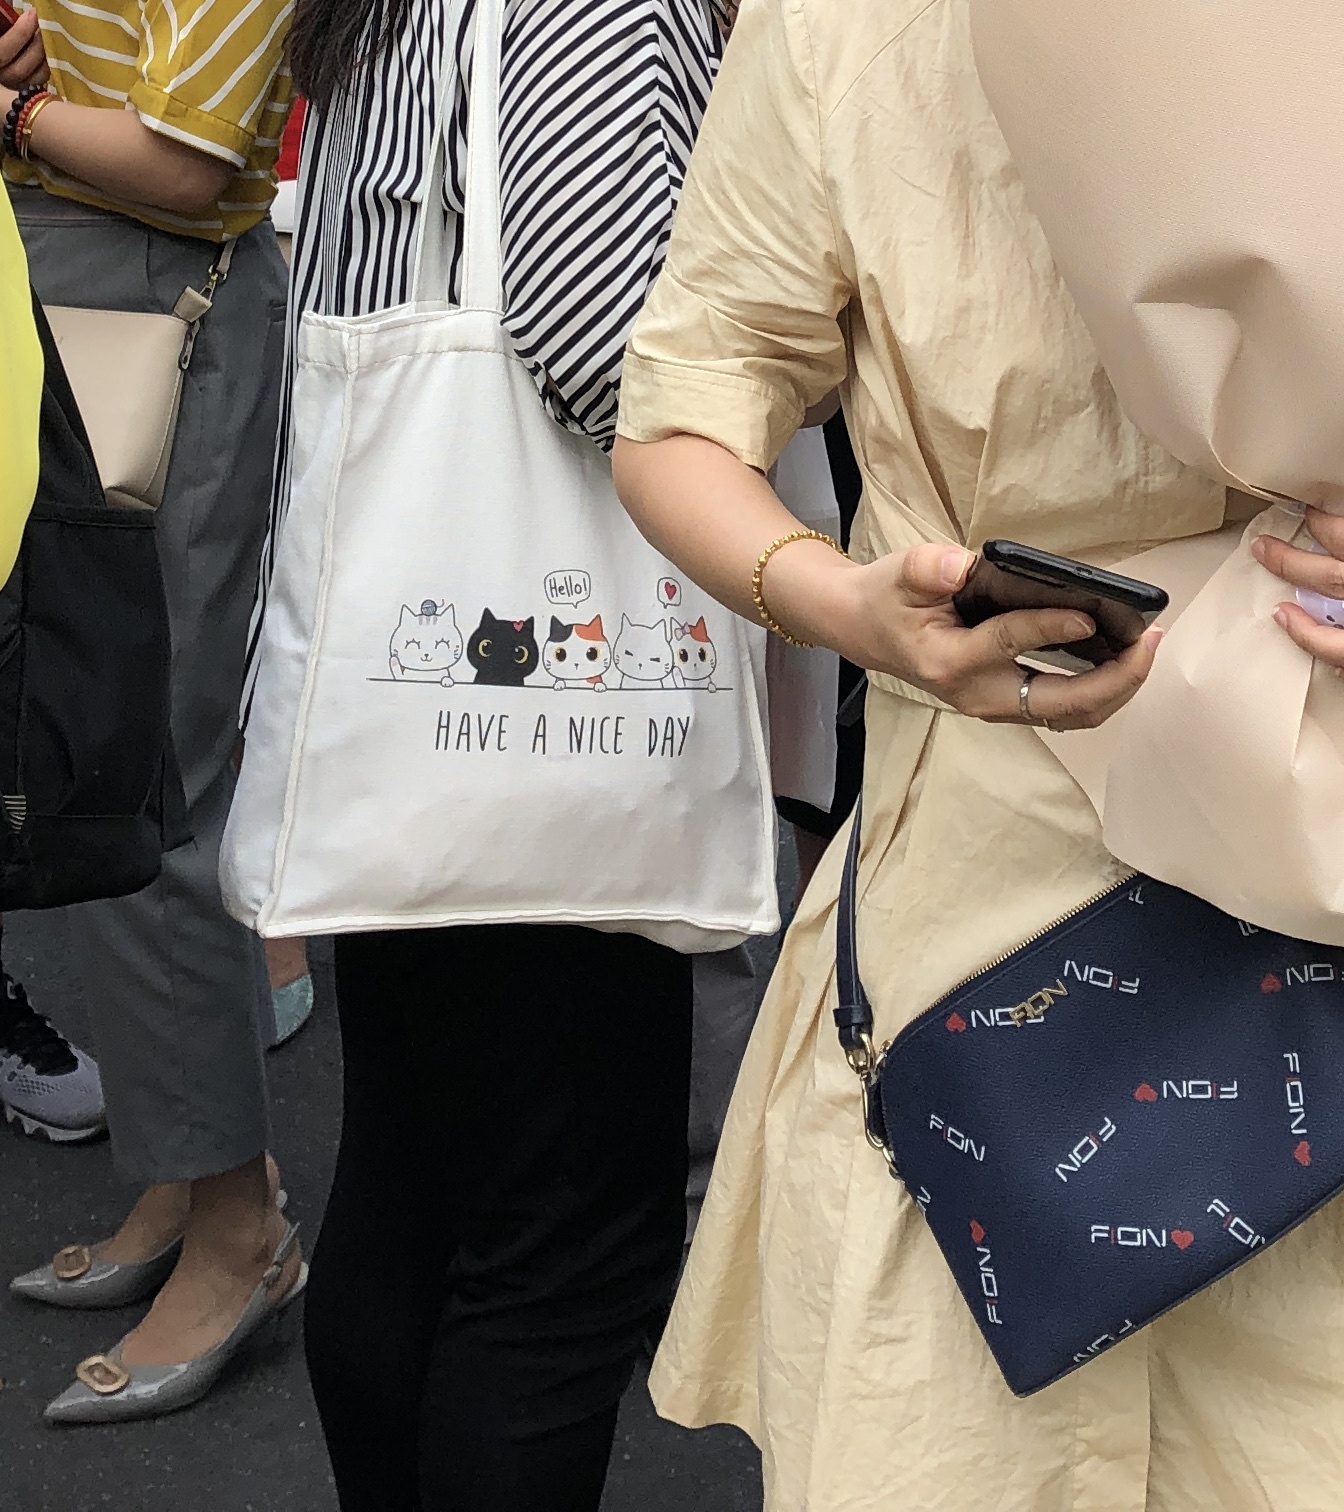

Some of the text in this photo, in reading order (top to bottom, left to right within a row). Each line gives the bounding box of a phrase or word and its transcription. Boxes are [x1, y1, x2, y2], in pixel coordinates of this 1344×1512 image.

[548, 575, 589, 600] Hello!
[434, 709, 691, 758] HAVE A NICE DAY
